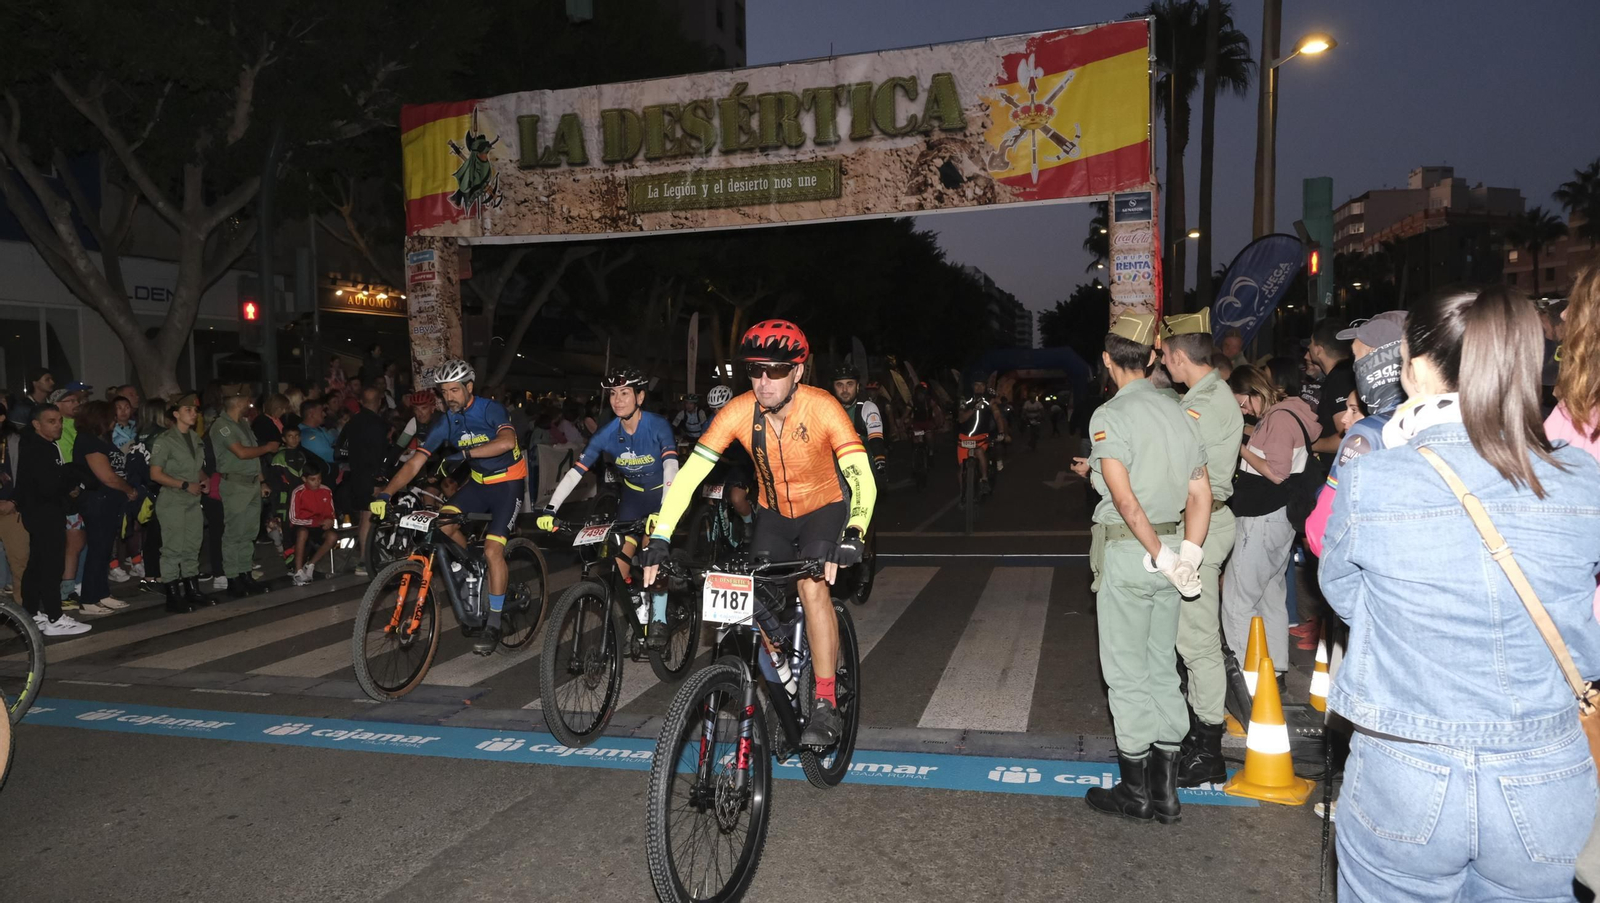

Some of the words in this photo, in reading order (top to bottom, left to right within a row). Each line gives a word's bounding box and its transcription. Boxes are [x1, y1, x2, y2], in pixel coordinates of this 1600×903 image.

[517, 112, 589, 168] LA
[601, 72, 968, 164] DESÉRTICA
[648, 185, 659, 198] La
[663, 181, 697, 200] Legión
[702, 184, 709, 197] y
[714, 178, 723, 193] el
[728, 177, 769, 192] desierto
[774, 177, 792, 189] nos
[798, 175, 817, 187] une
[1116, 260, 1151, 270] RENTA
[1261, 263, 1290, 295] JUEGA
[581, 528, 606, 539] 7498
[710, 589, 749, 611] 7187
[117, 714, 236, 729] cajamar
[311, 728, 442, 745] cajamar
[529, 743, 653, 760] cajama
